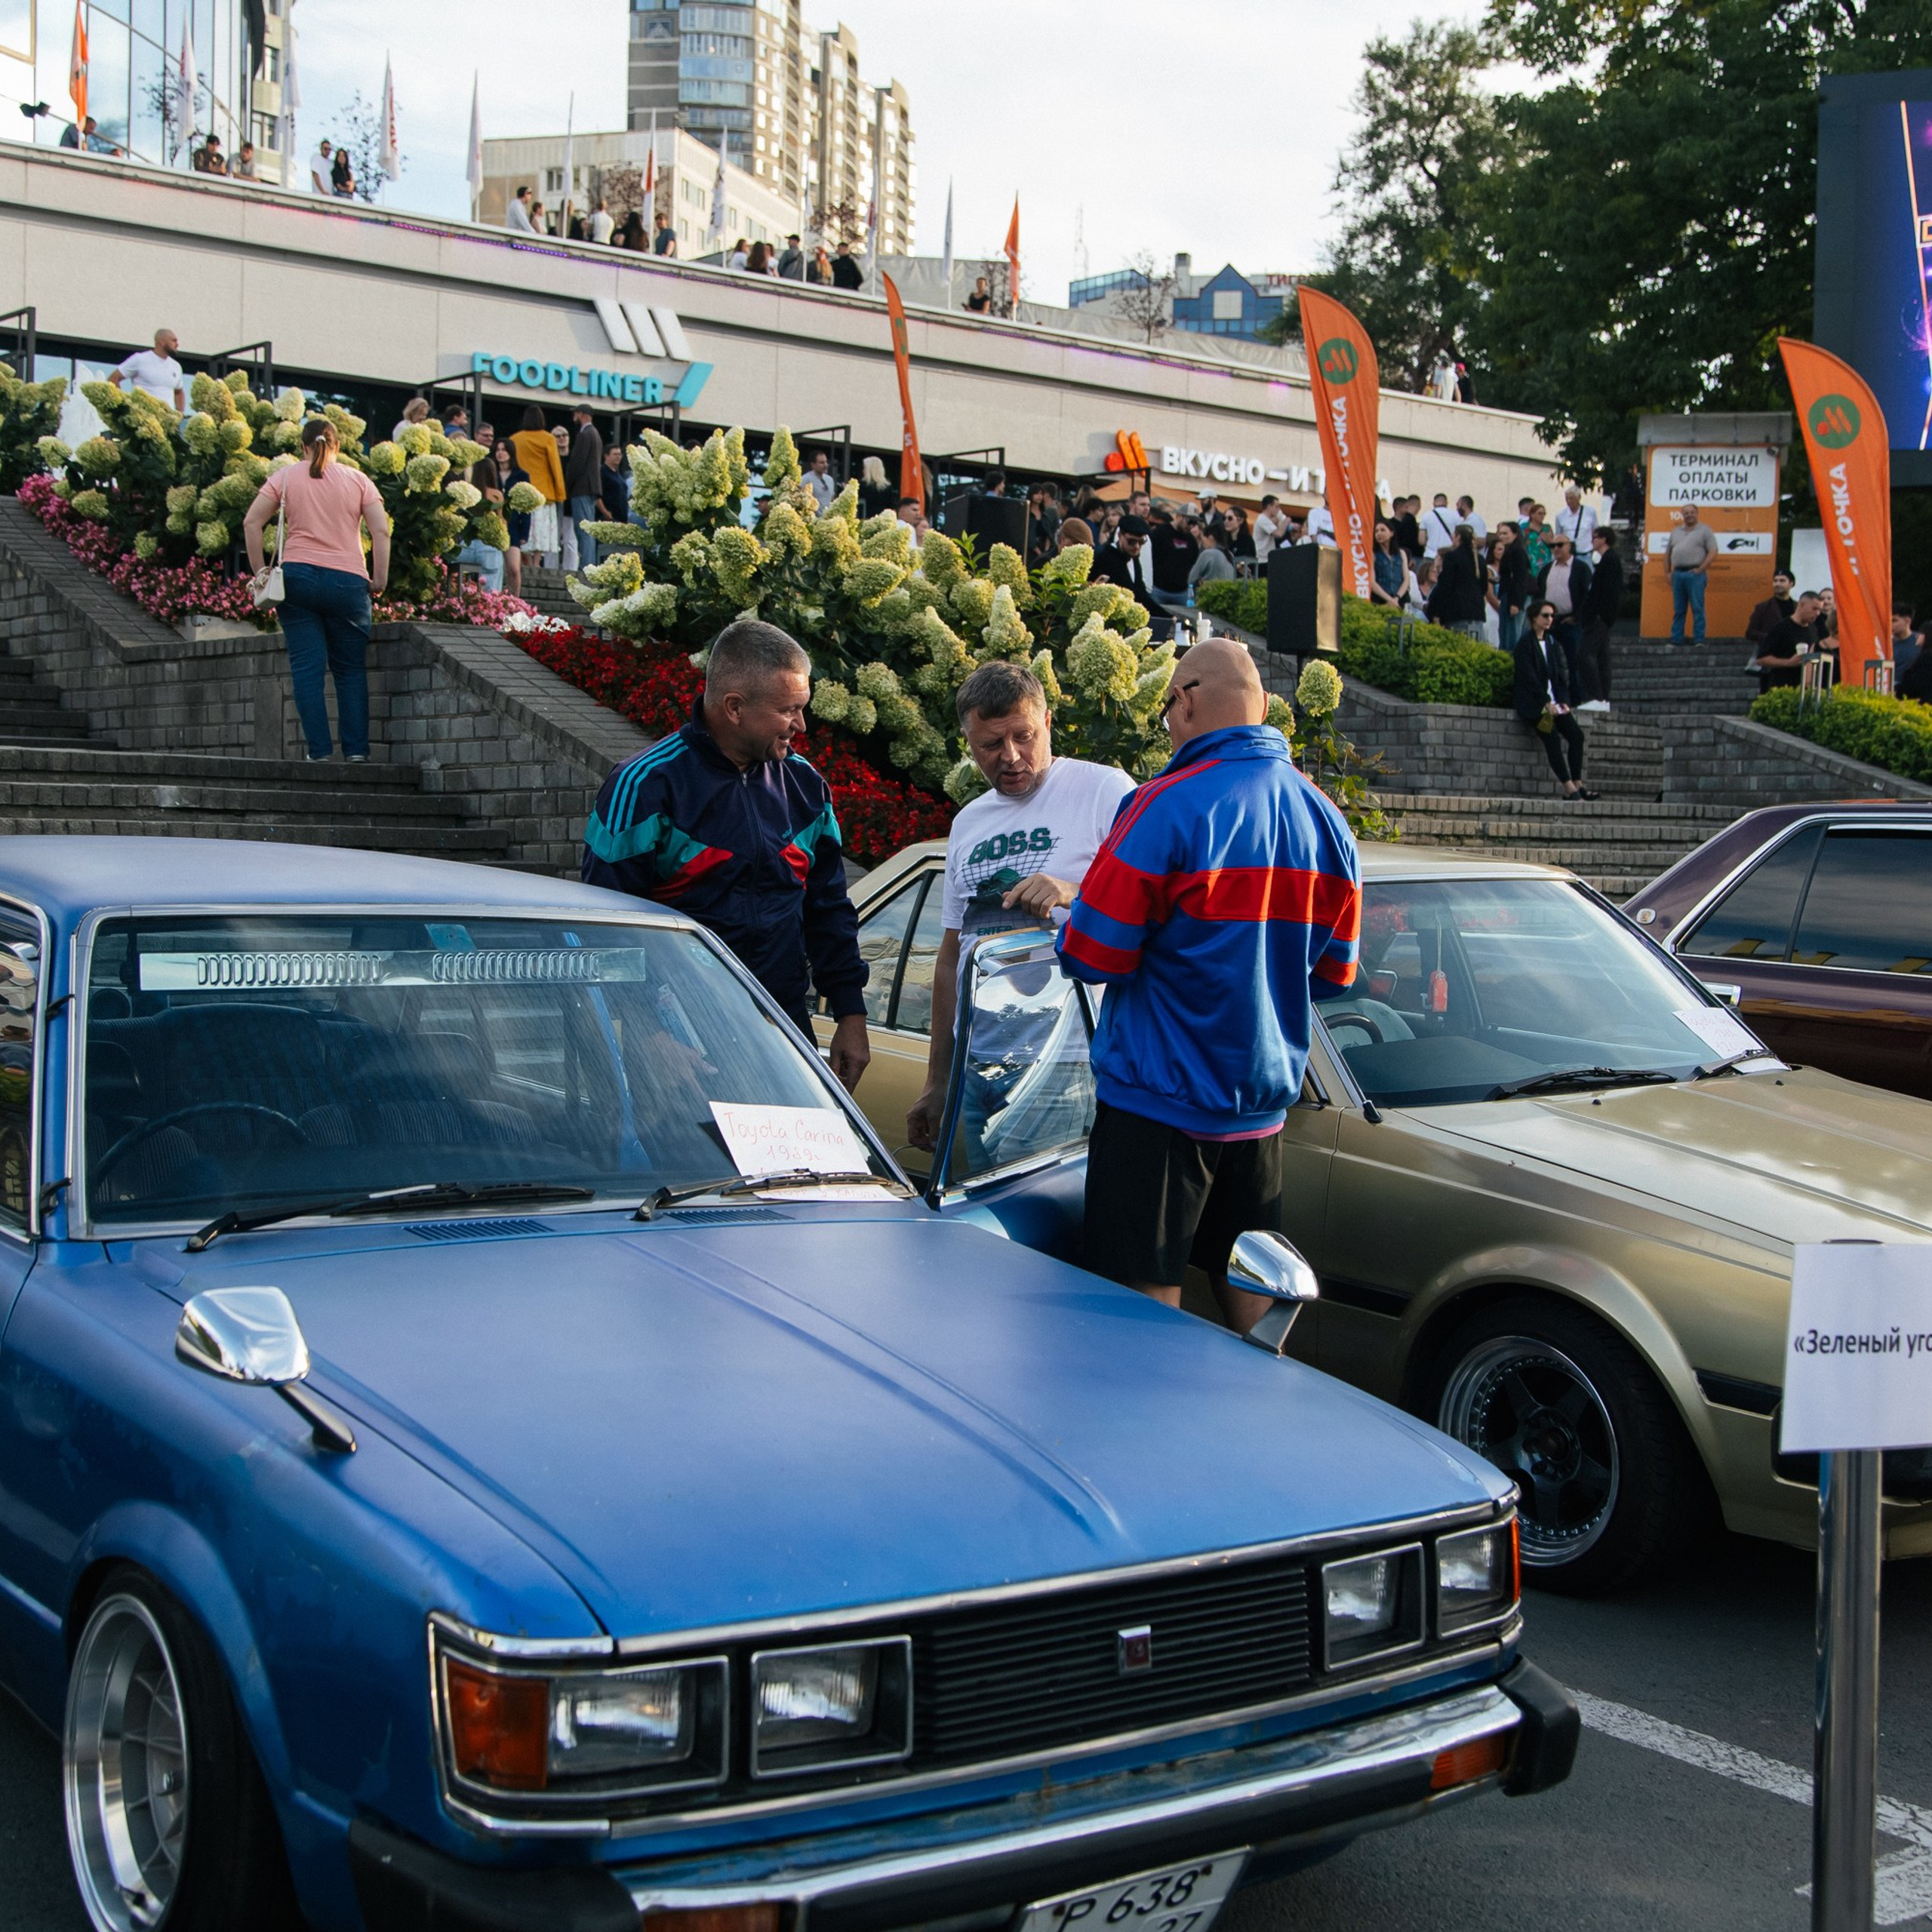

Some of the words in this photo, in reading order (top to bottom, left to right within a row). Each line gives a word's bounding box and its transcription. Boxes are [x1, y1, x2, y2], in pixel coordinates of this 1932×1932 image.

[472, 352, 664, 404] FOODLINER
[1332, 395, 1349, 467] ОЧКА
[1161, 446, 1265, 485] ВКУСНО
[1670, 454, 1758, 466] ТЕРМИНАЛ
[1679, 472, 1748, 484] ОПЛАТЫ
[1669, 489, 1757, 501] ПАРКОВКИ
[1349, 513, 1370, 598] ВКУСНО
[968, 828, 1051, 865] BOSS
[723, 1112, 788, 1145] Toyota
[795, 1119, 844, 1146] Carina
[1794, 1327, 1900, 1354] «Зеленый
[1106, 1869, 1199, 1924] 638
